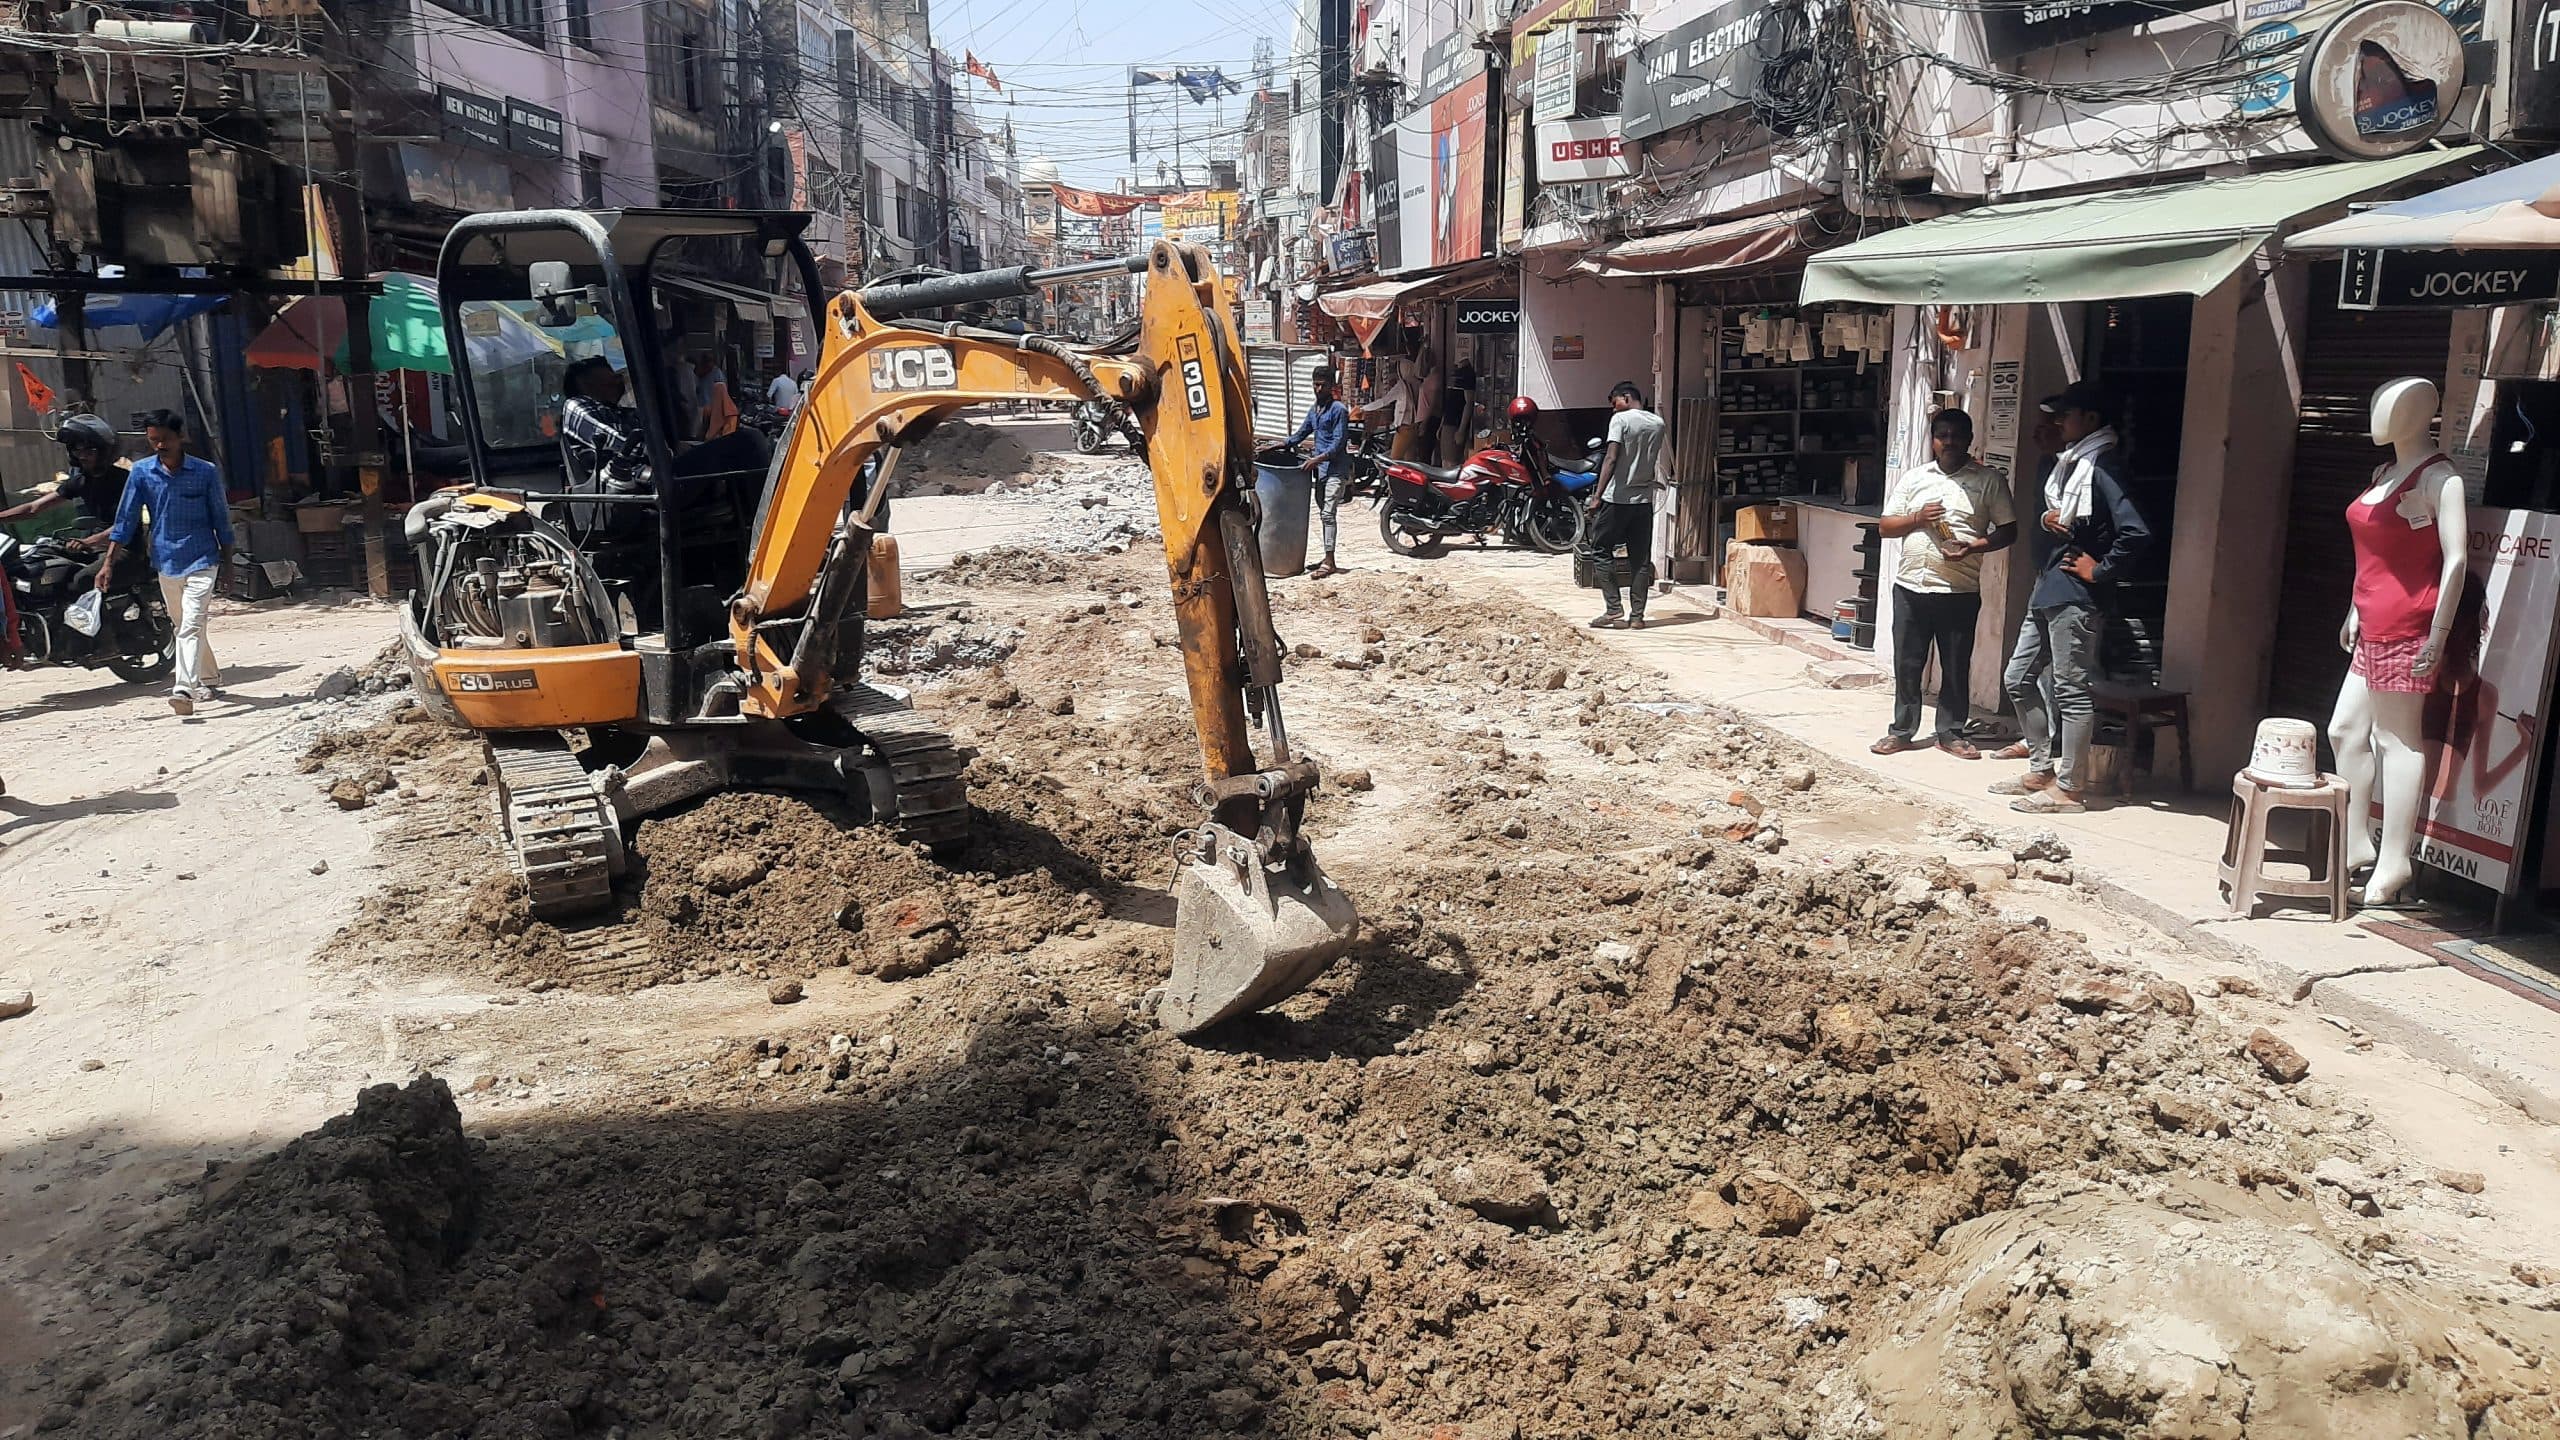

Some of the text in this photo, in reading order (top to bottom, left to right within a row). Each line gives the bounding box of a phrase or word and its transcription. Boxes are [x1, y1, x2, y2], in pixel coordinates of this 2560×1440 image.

[1646, 49, 1679, 85] JAIN
[2376, 96, 2437, 128] JOCKEY
[1555, 140, 1620, 159] USHA
[2409, 270, 2528, 298] JOCKEY
[1459, 310, 1520, 324] JOCKEY
[871, 348, 957, 389] JCB
[1183, 361, 1206, 409] 30
[2467, 531, 2553, 559] DYCARE
[494, 678, 534, 690] PLUS
[2411, 840, 2478, 879] ARAYAN
